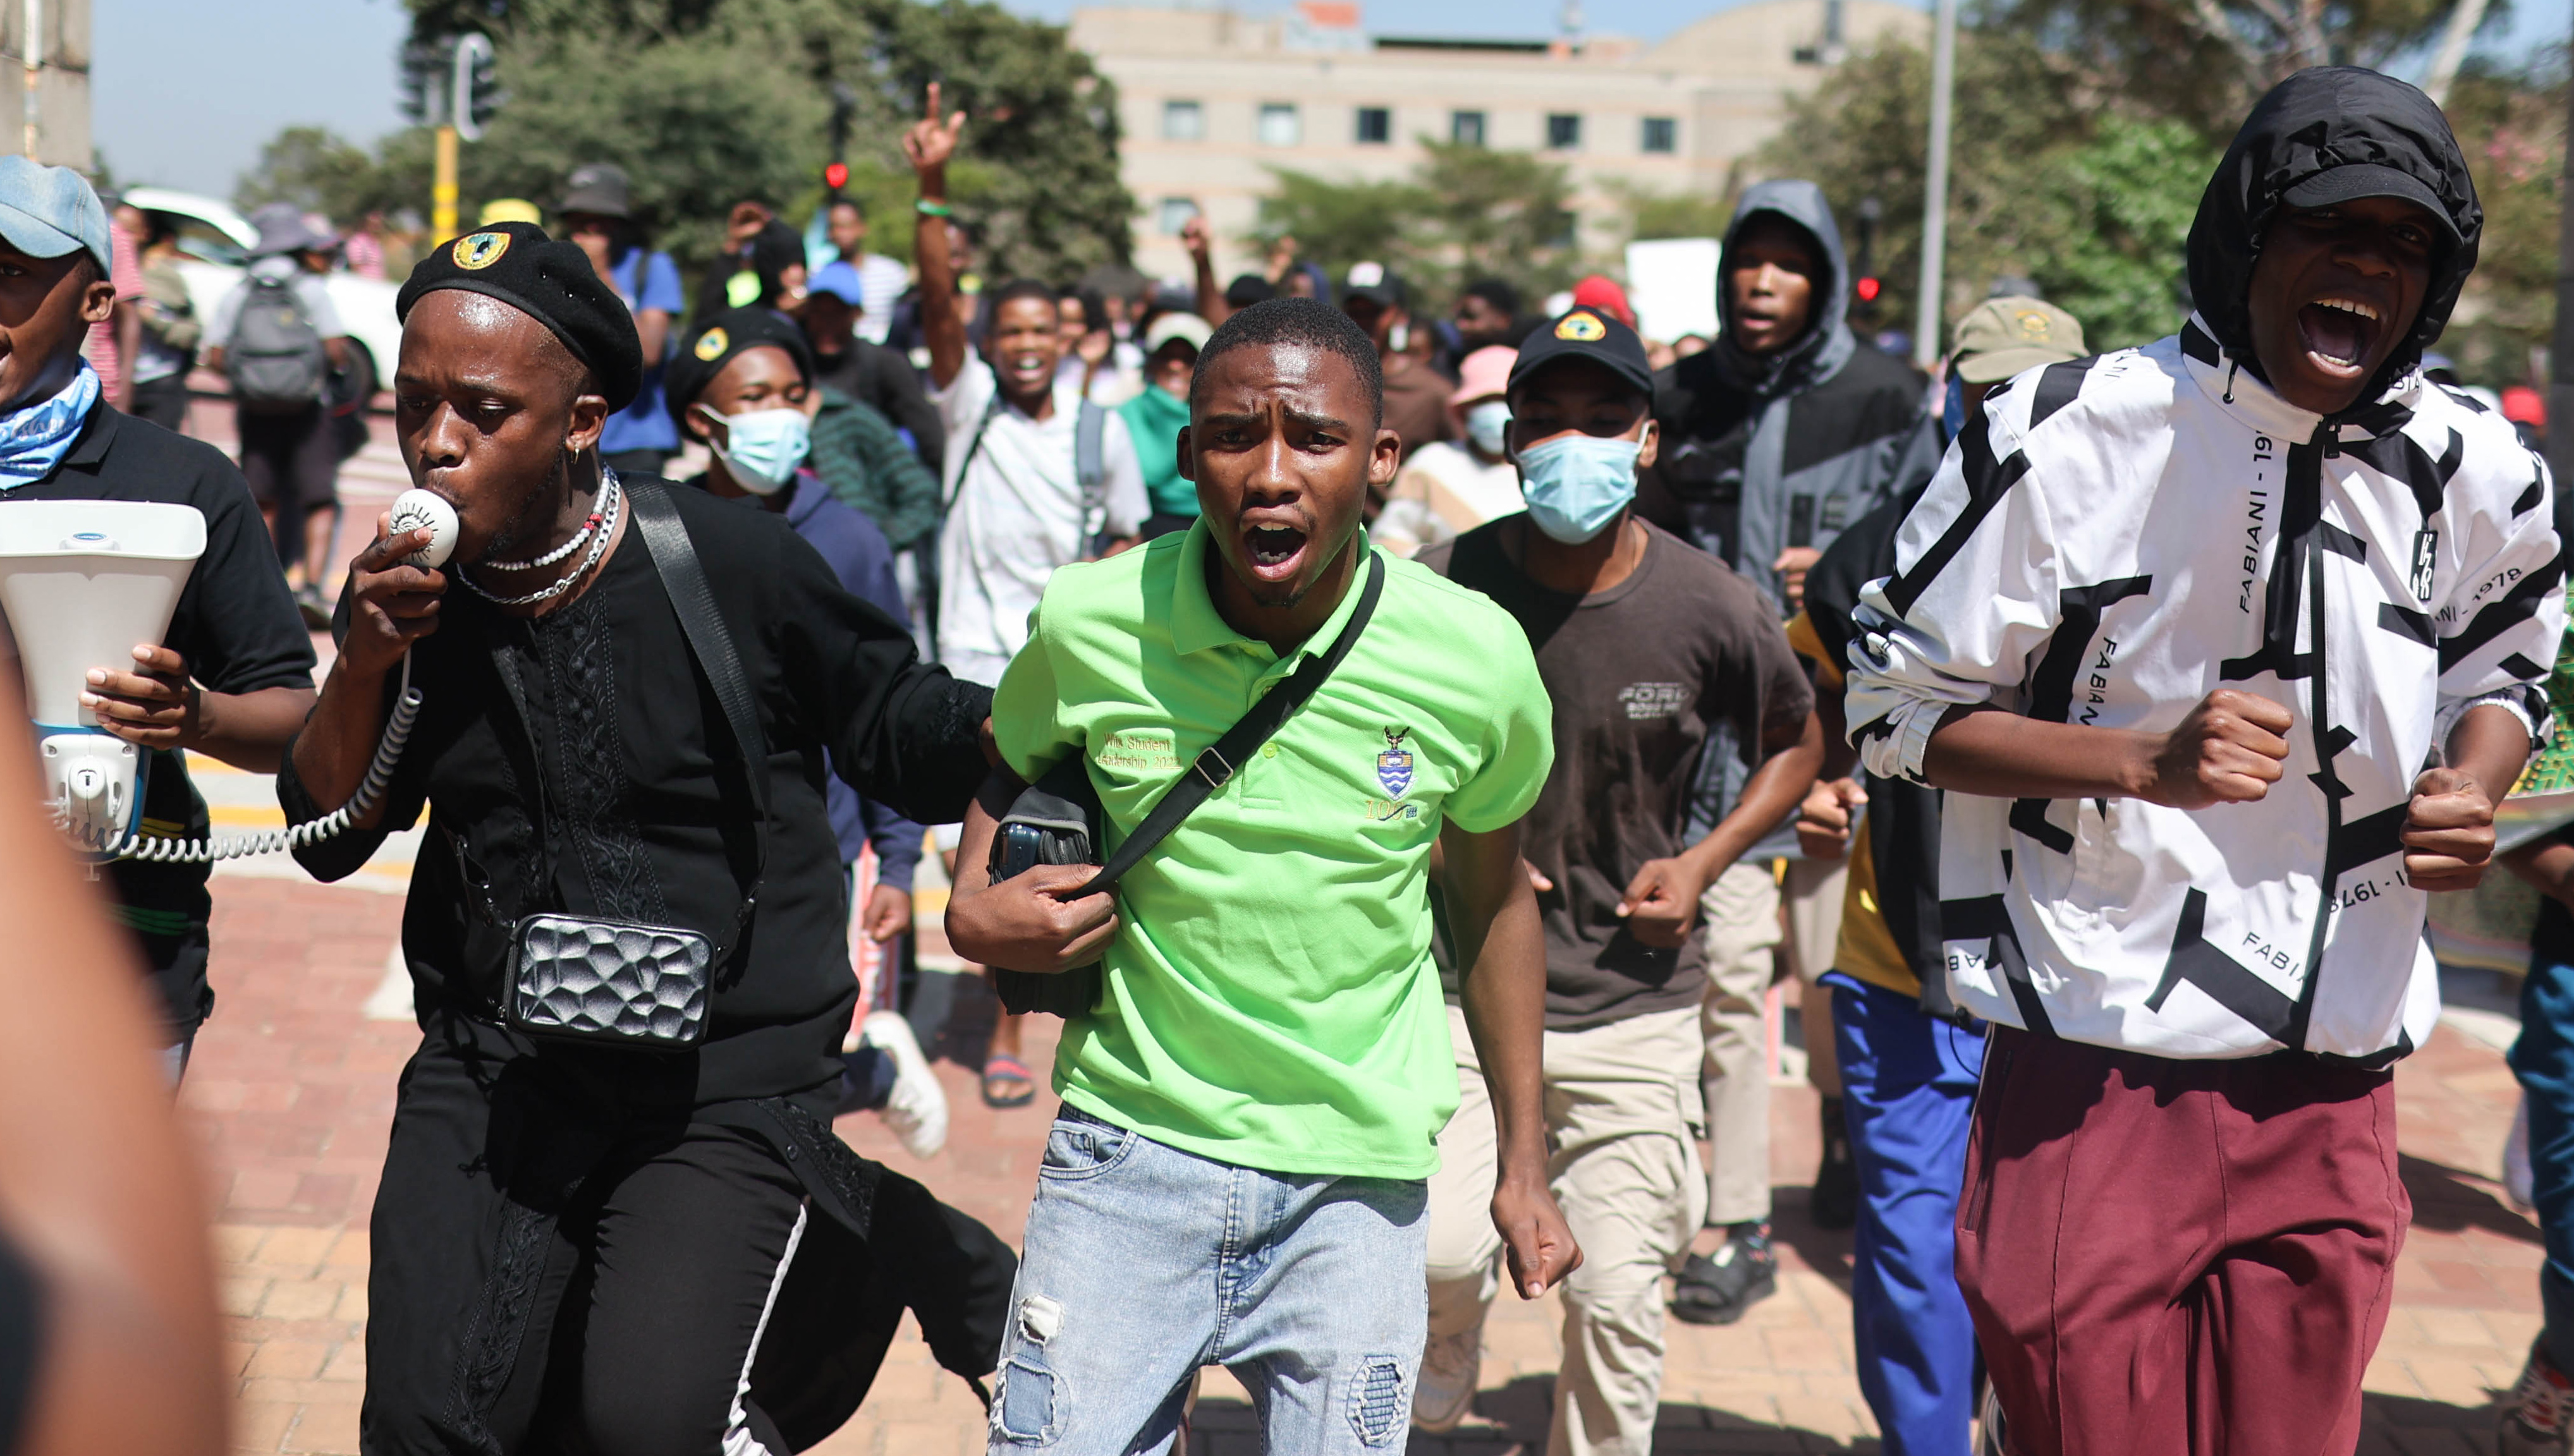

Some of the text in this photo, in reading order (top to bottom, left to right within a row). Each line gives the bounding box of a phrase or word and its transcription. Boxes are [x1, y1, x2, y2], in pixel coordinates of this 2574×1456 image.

[2240, 490, 2267, 614] FABIANI
[2254, 430, 2272, 462] 19
[2472, 568, 2522, 602] 1978
[1127, 736, 1171, 751] Student
[1098, 750, 1181, 770] Leadership 2022
[1365, 800, 1403, 820] 100
